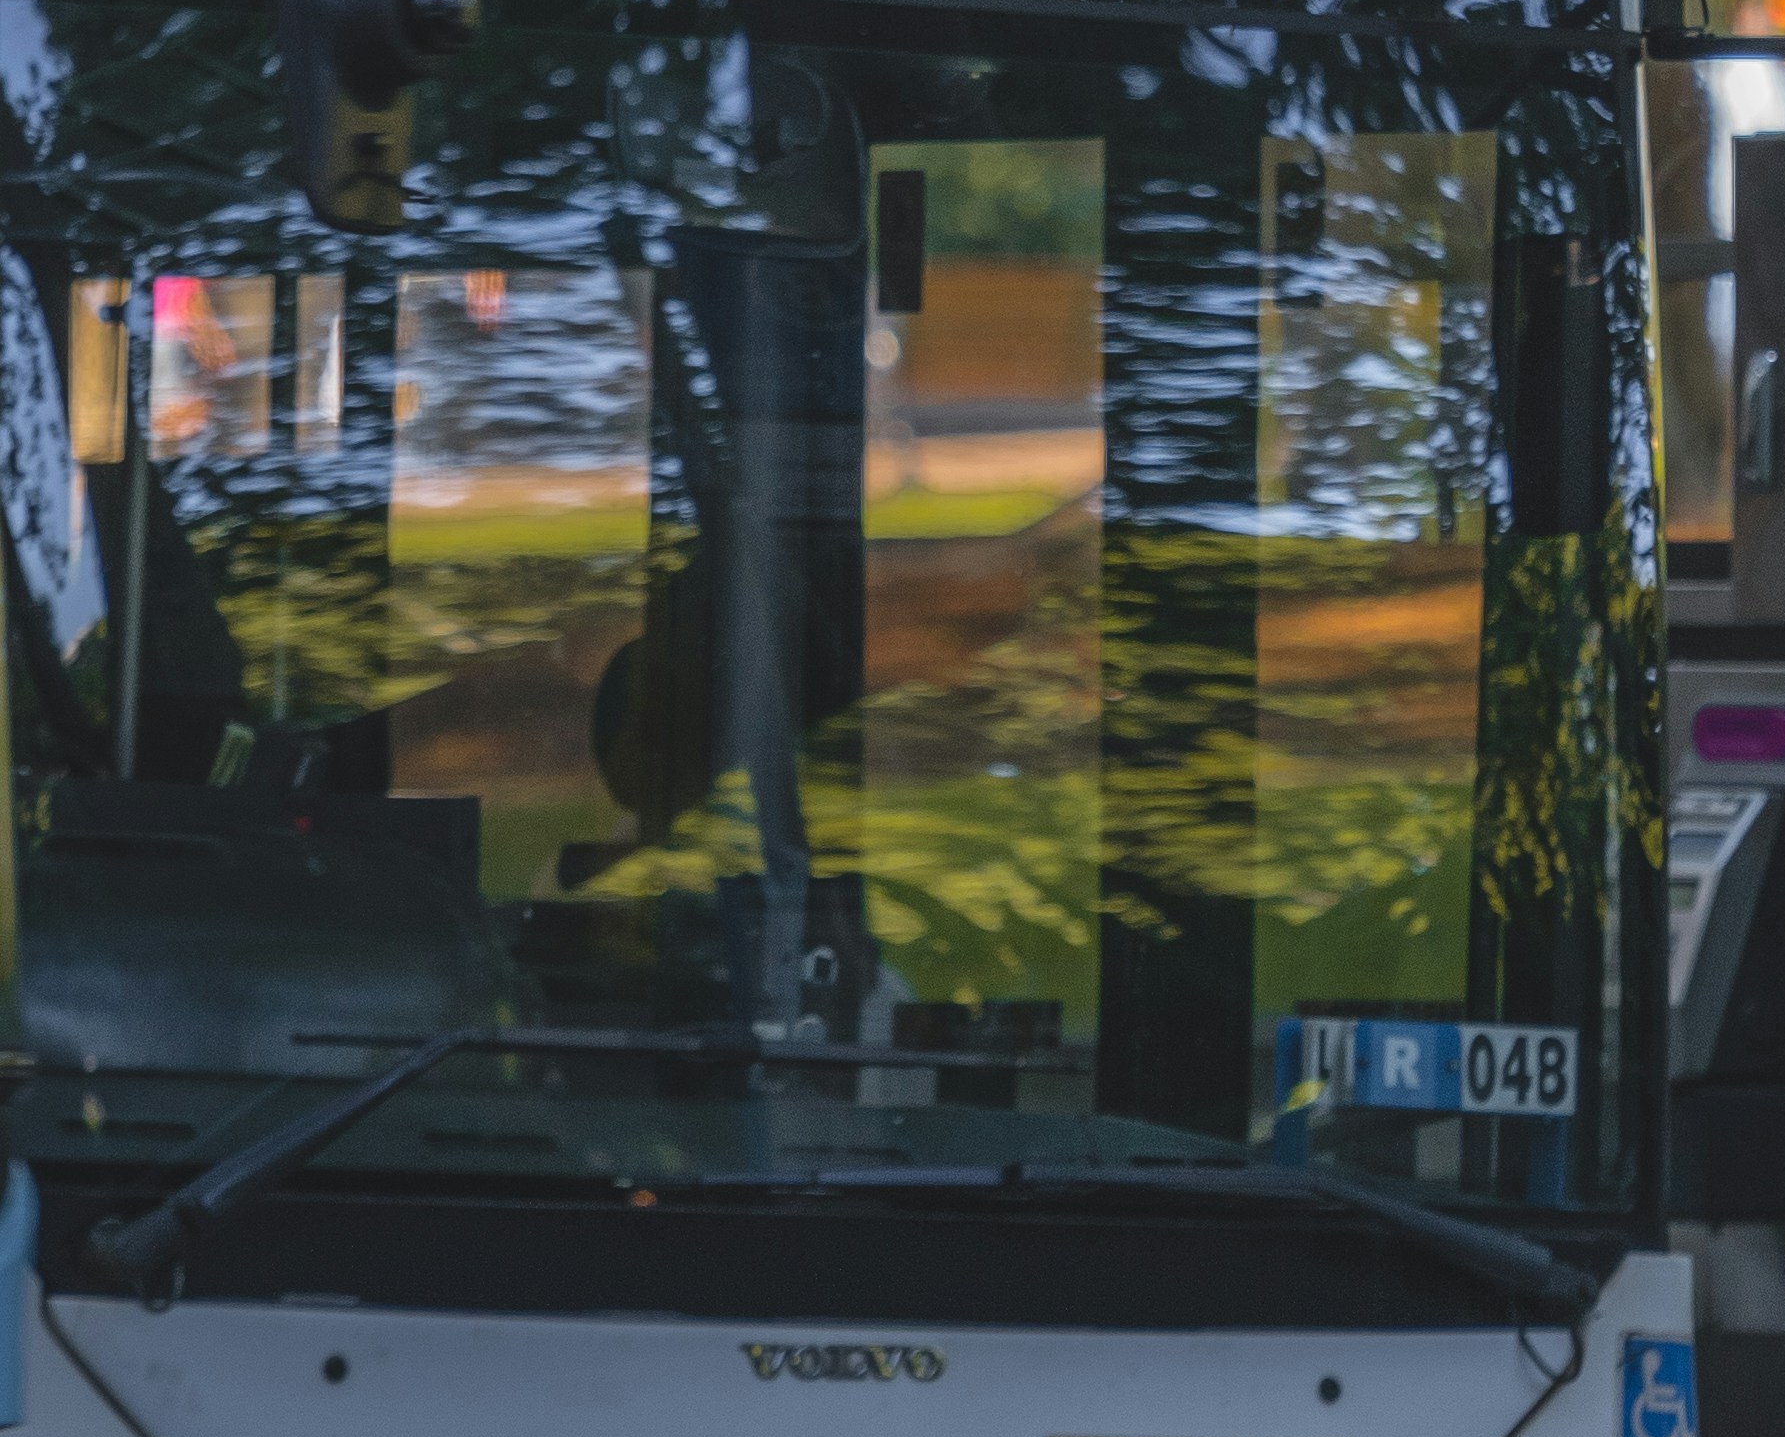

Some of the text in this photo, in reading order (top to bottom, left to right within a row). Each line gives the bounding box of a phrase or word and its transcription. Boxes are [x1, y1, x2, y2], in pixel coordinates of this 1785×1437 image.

[1382, 1035, 1421, 1089] R
[1467, 1032, 1569, 1107] 048
[740, 1343, 947, 1383] VOLVO
